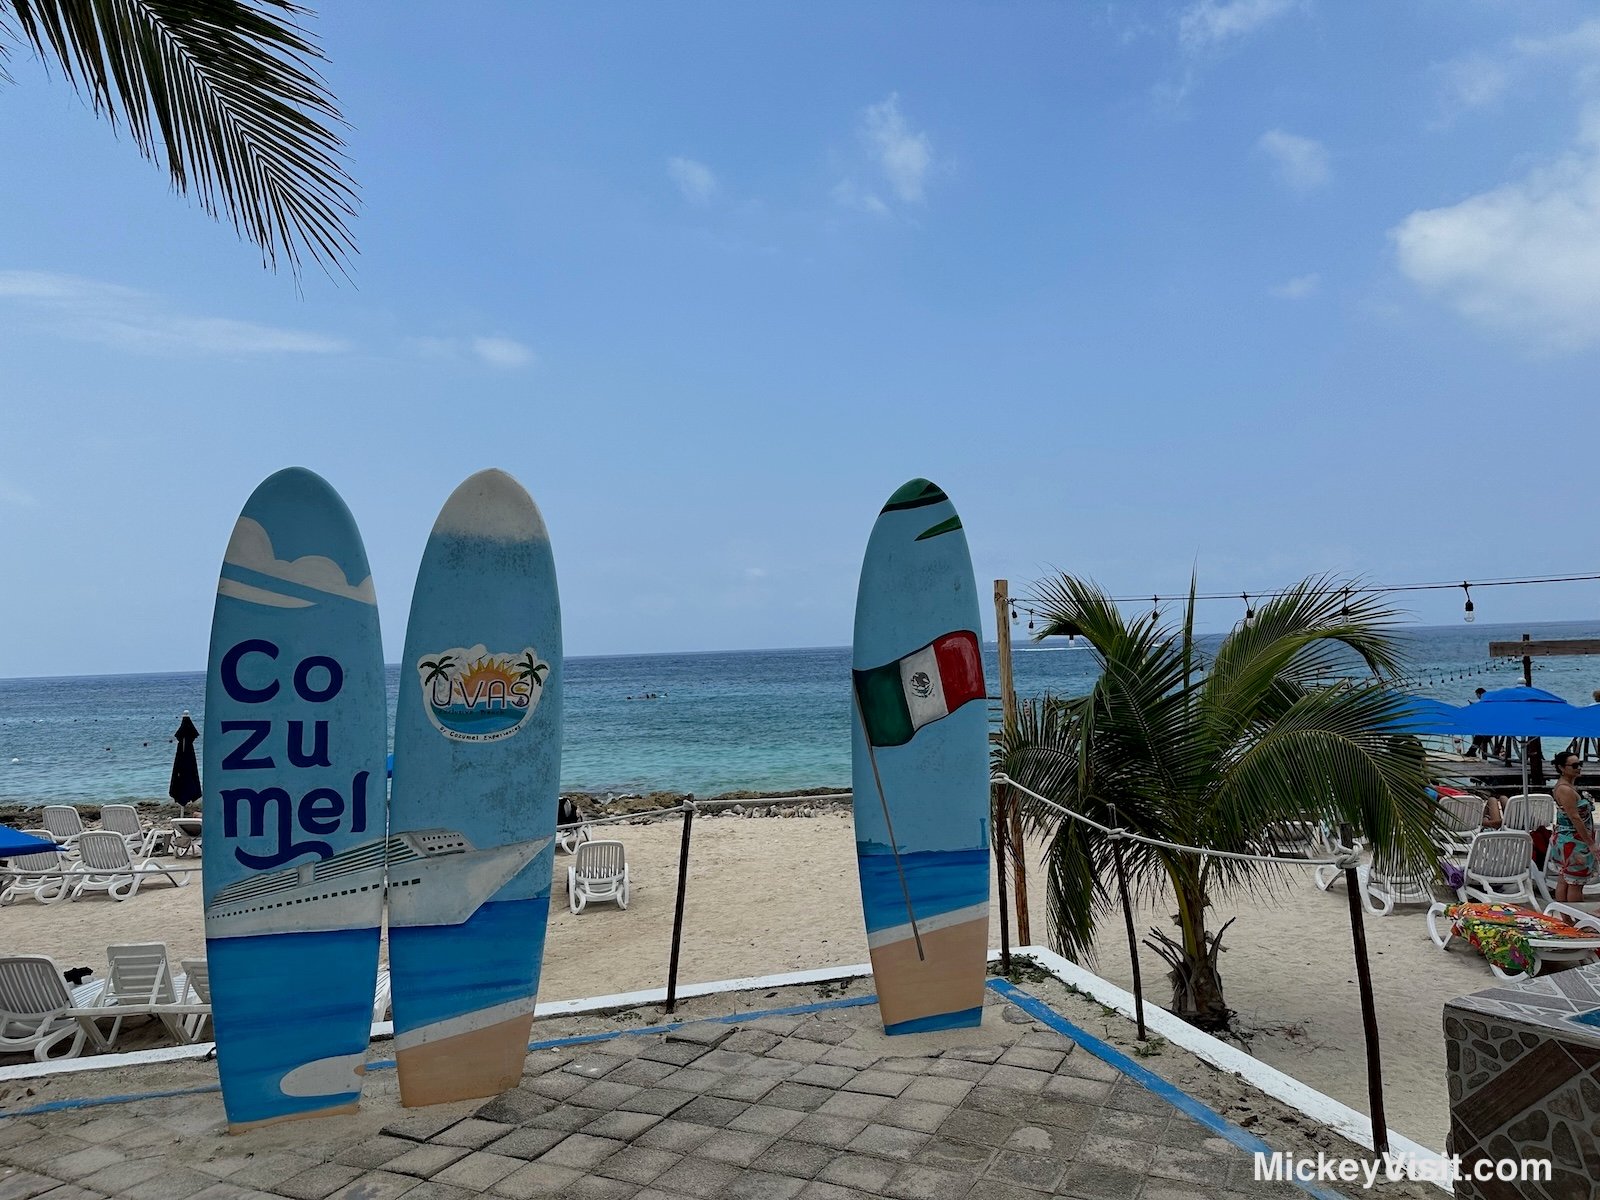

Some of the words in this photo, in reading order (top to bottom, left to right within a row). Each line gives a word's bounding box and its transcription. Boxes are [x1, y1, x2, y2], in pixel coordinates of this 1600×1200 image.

[220, 638, 344, 704] Co
[431, 680, 531, 709] UVAS
[220, 720, 333, 771] zu
[449, 731, 479, 741] Cozumel
[219, 770, 370, 871] mel
